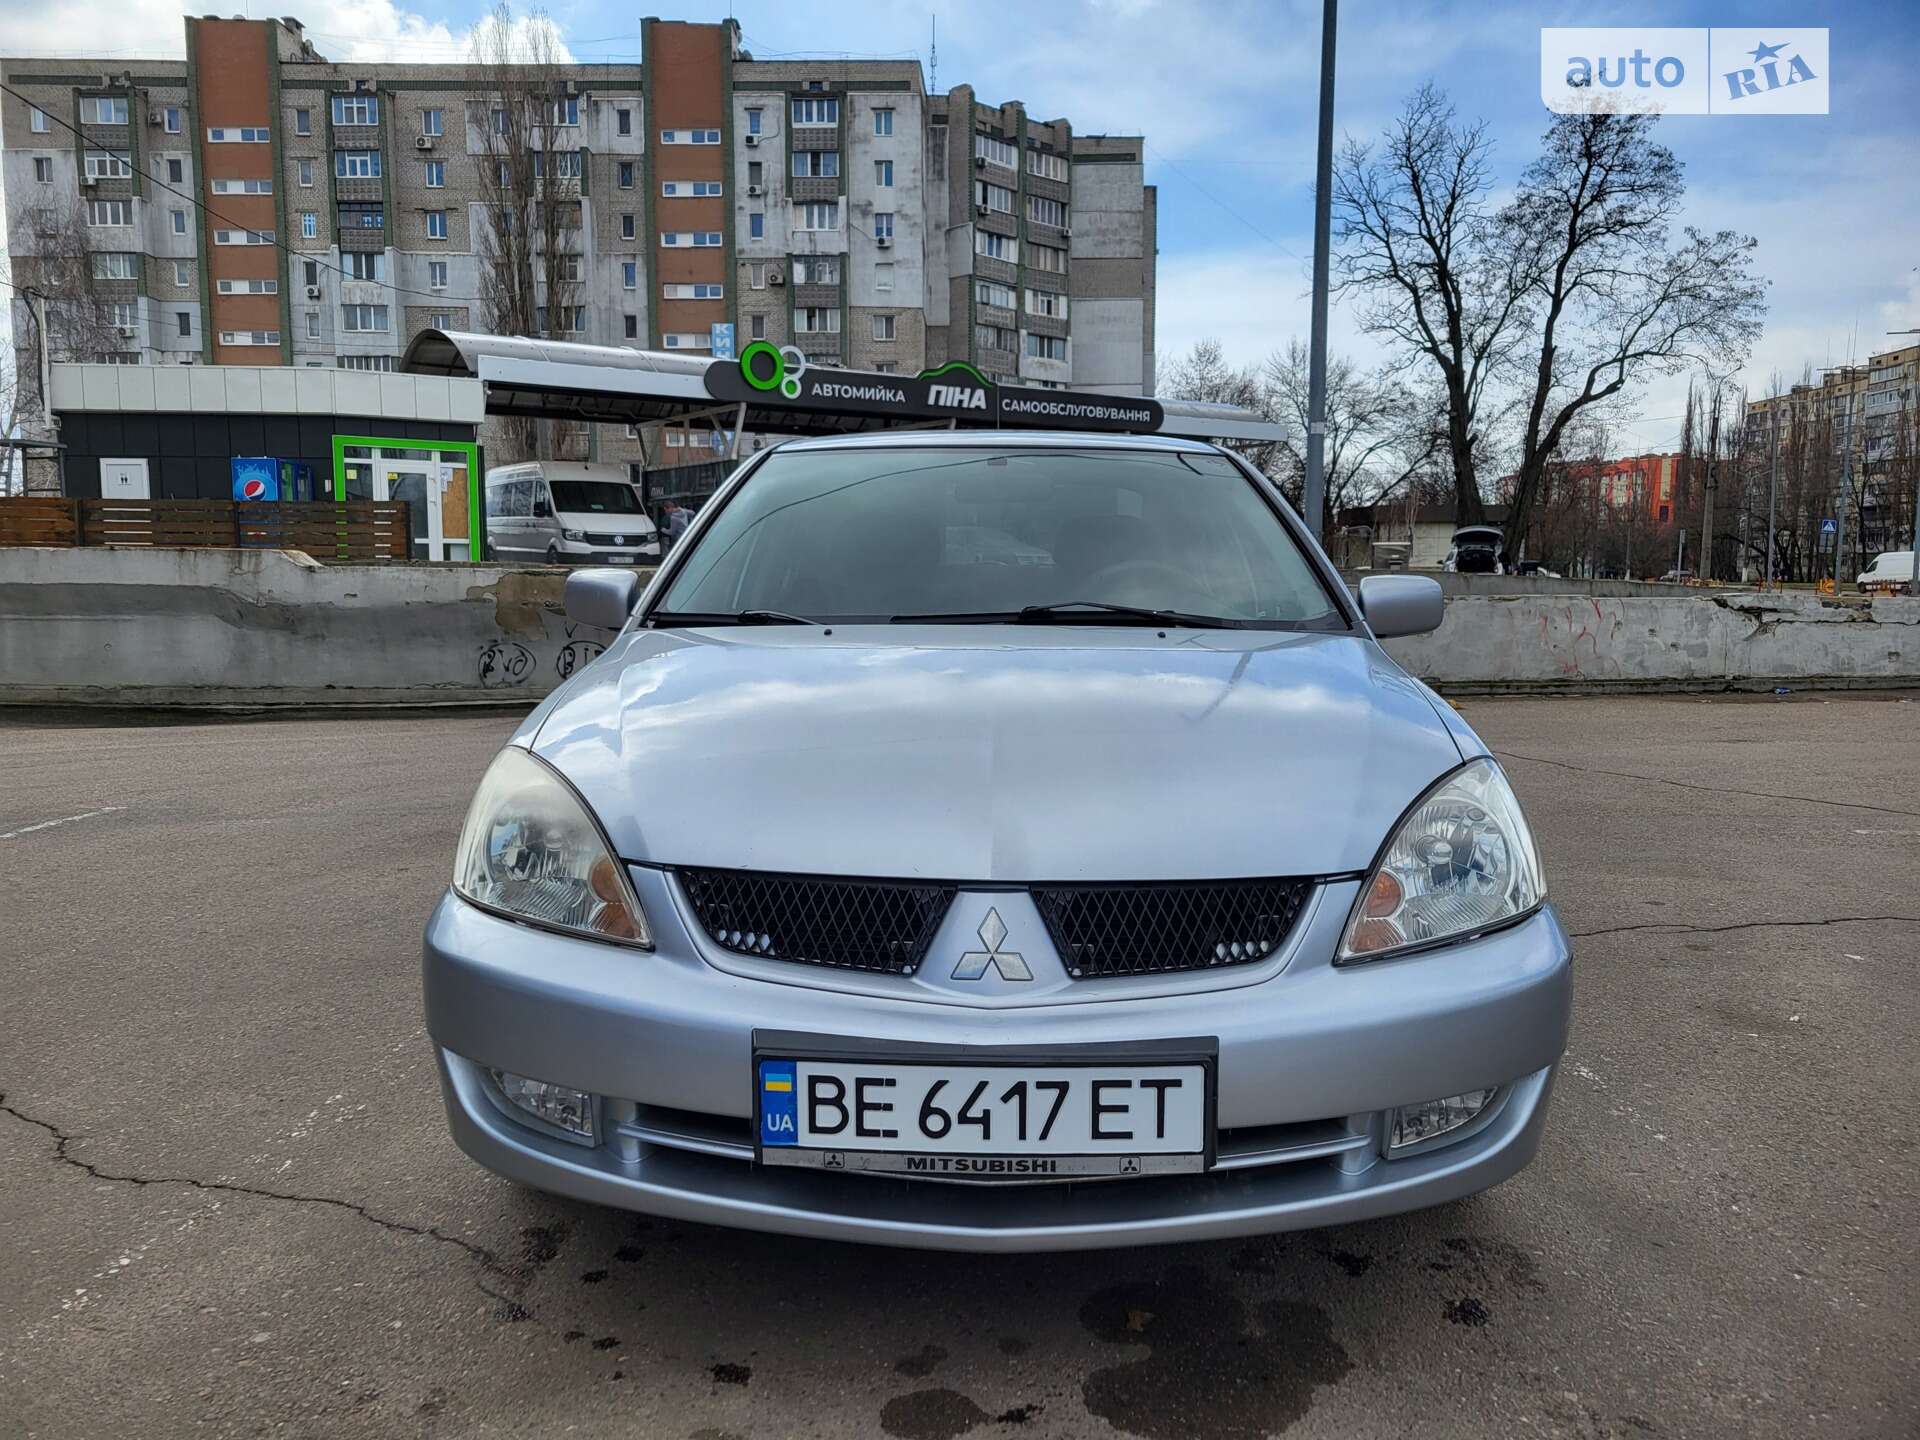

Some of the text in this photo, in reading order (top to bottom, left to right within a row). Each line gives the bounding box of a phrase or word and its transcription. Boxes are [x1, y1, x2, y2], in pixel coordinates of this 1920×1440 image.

[811, 382, 1151, 423] АВТОМИЙКА ПІНА САМООБСЛУГОВУВАННЯ
[808, 1074, 1183, 1141] BE 6417 ET
[767, 1113, 794, 1133] UA
[906, 1156, 1057, 1174] MITSUBISHI
